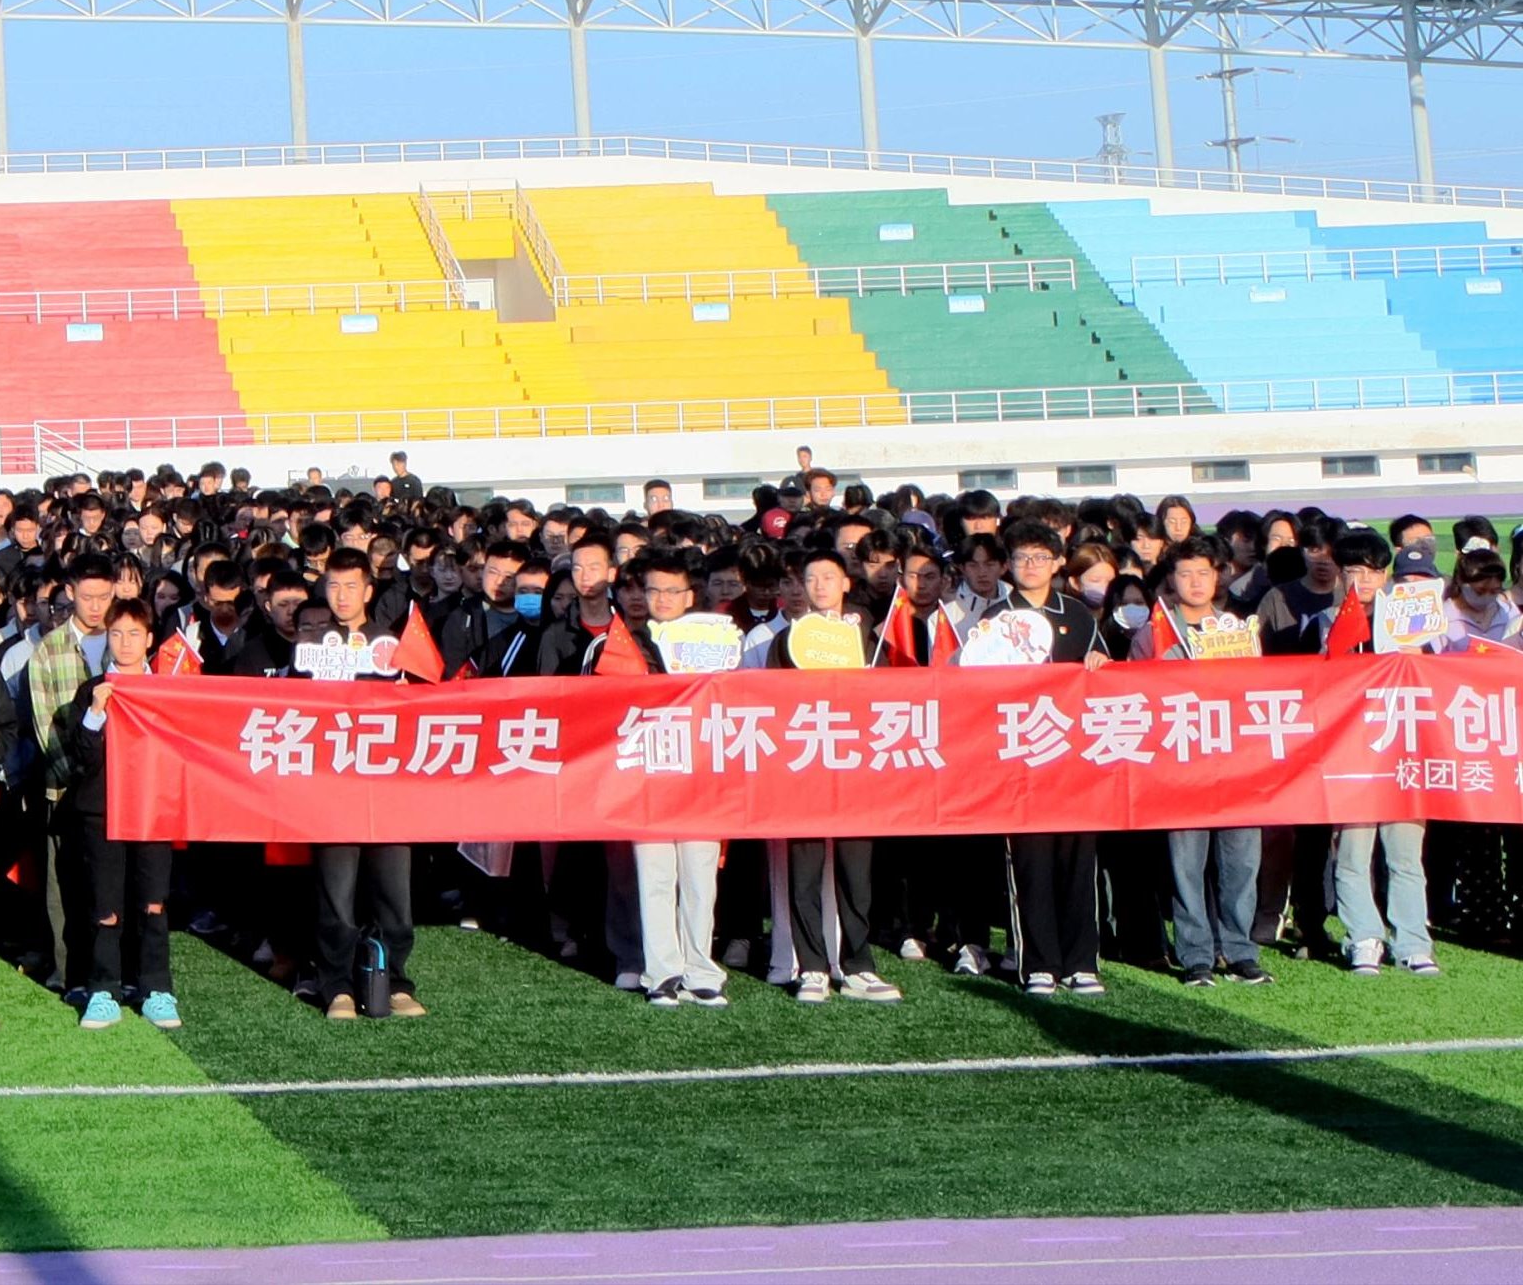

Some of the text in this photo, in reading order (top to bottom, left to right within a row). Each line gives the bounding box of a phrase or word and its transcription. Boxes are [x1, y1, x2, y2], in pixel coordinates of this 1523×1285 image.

[239, 684, 1519, 776] 铭记历史 缅怀先烈 珍爱和平 开创
